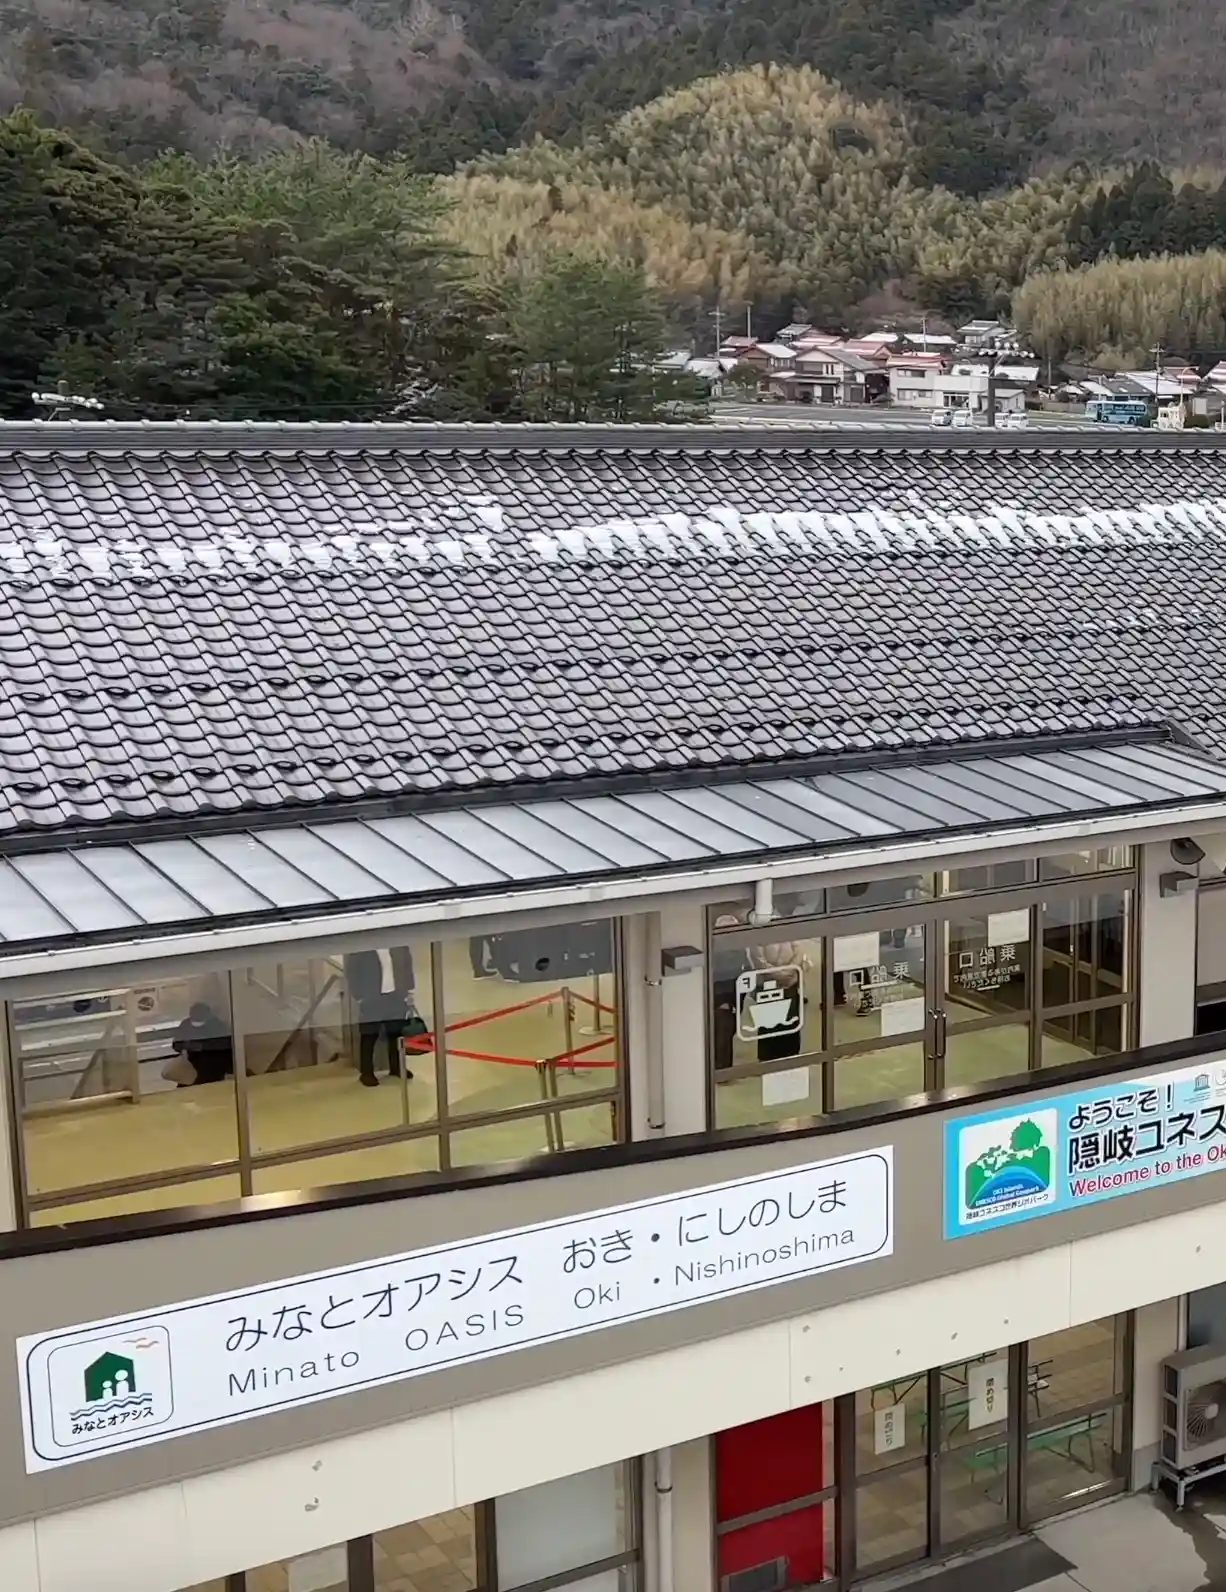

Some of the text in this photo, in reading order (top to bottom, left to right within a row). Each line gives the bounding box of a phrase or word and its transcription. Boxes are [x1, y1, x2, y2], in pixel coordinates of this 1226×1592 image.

[1069, 1167, 1150, 1197] Welcome
[1155, 1160, 1171, 1176] to
[1176, 1153, 1202, 1171] the
[225, 1256, 523, 1352] みなとオアシス
[228, 1351, 360, 1397] Minato
[405, 1304, 524, 1351] OASIS
[574, 1281, 621, 1309] Oki
[675, 1229, 855, 1286] Nishinoshima
[72, 1406, 154, 1435] みなとオアシス
